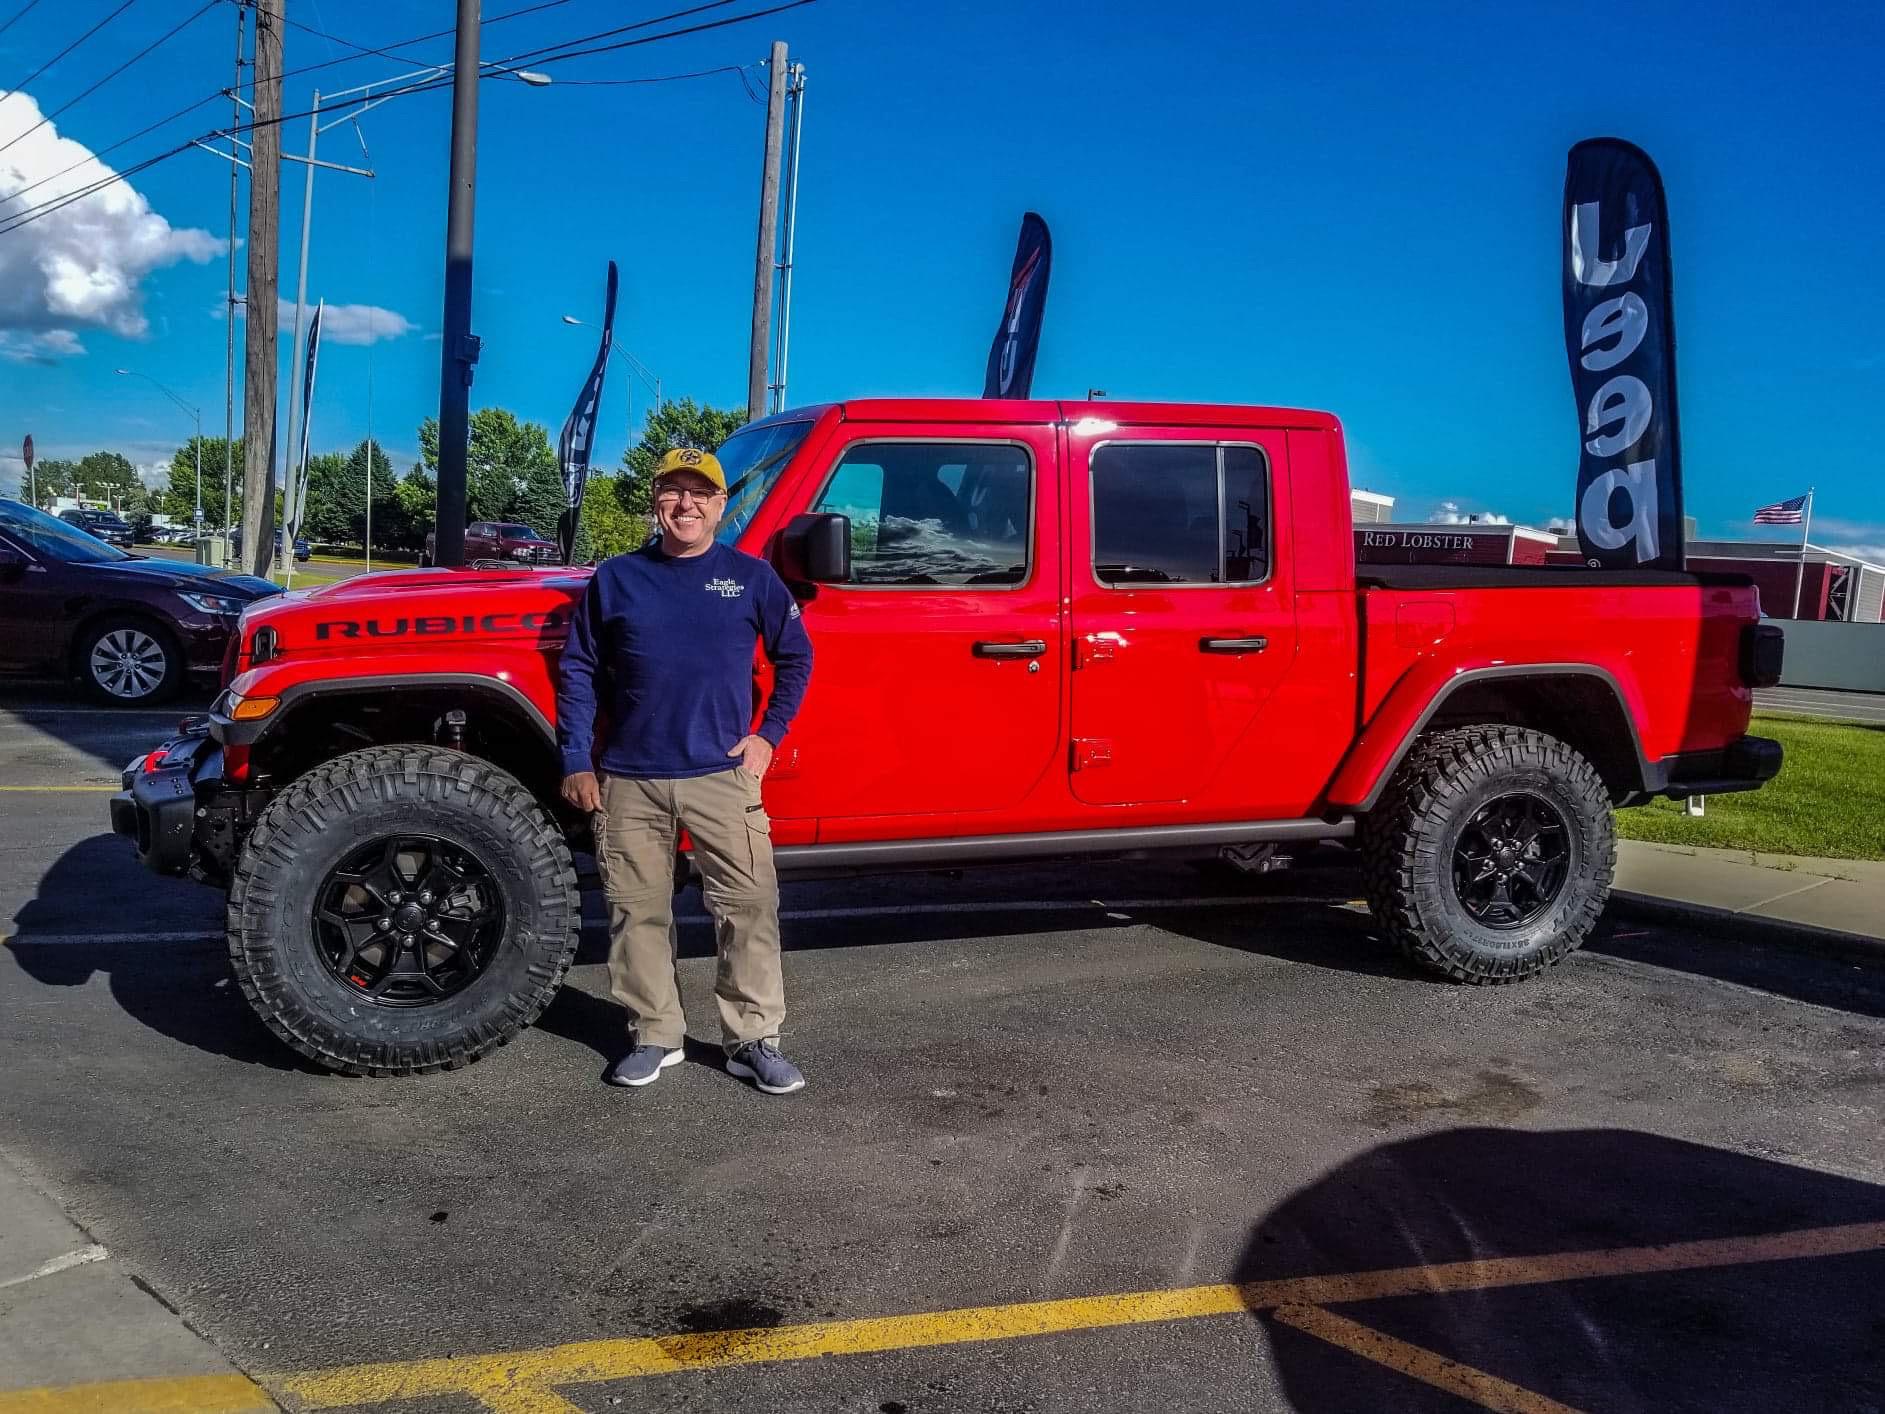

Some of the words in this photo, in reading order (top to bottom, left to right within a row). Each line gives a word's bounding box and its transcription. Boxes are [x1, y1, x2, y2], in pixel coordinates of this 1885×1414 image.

[1363, 531, 1396, 547] RED
[1400, 532, 1473, 549] LOBSTER
[713, 578, 736, 586] Eagle
[316, 611, 572, 640] RUBICO
